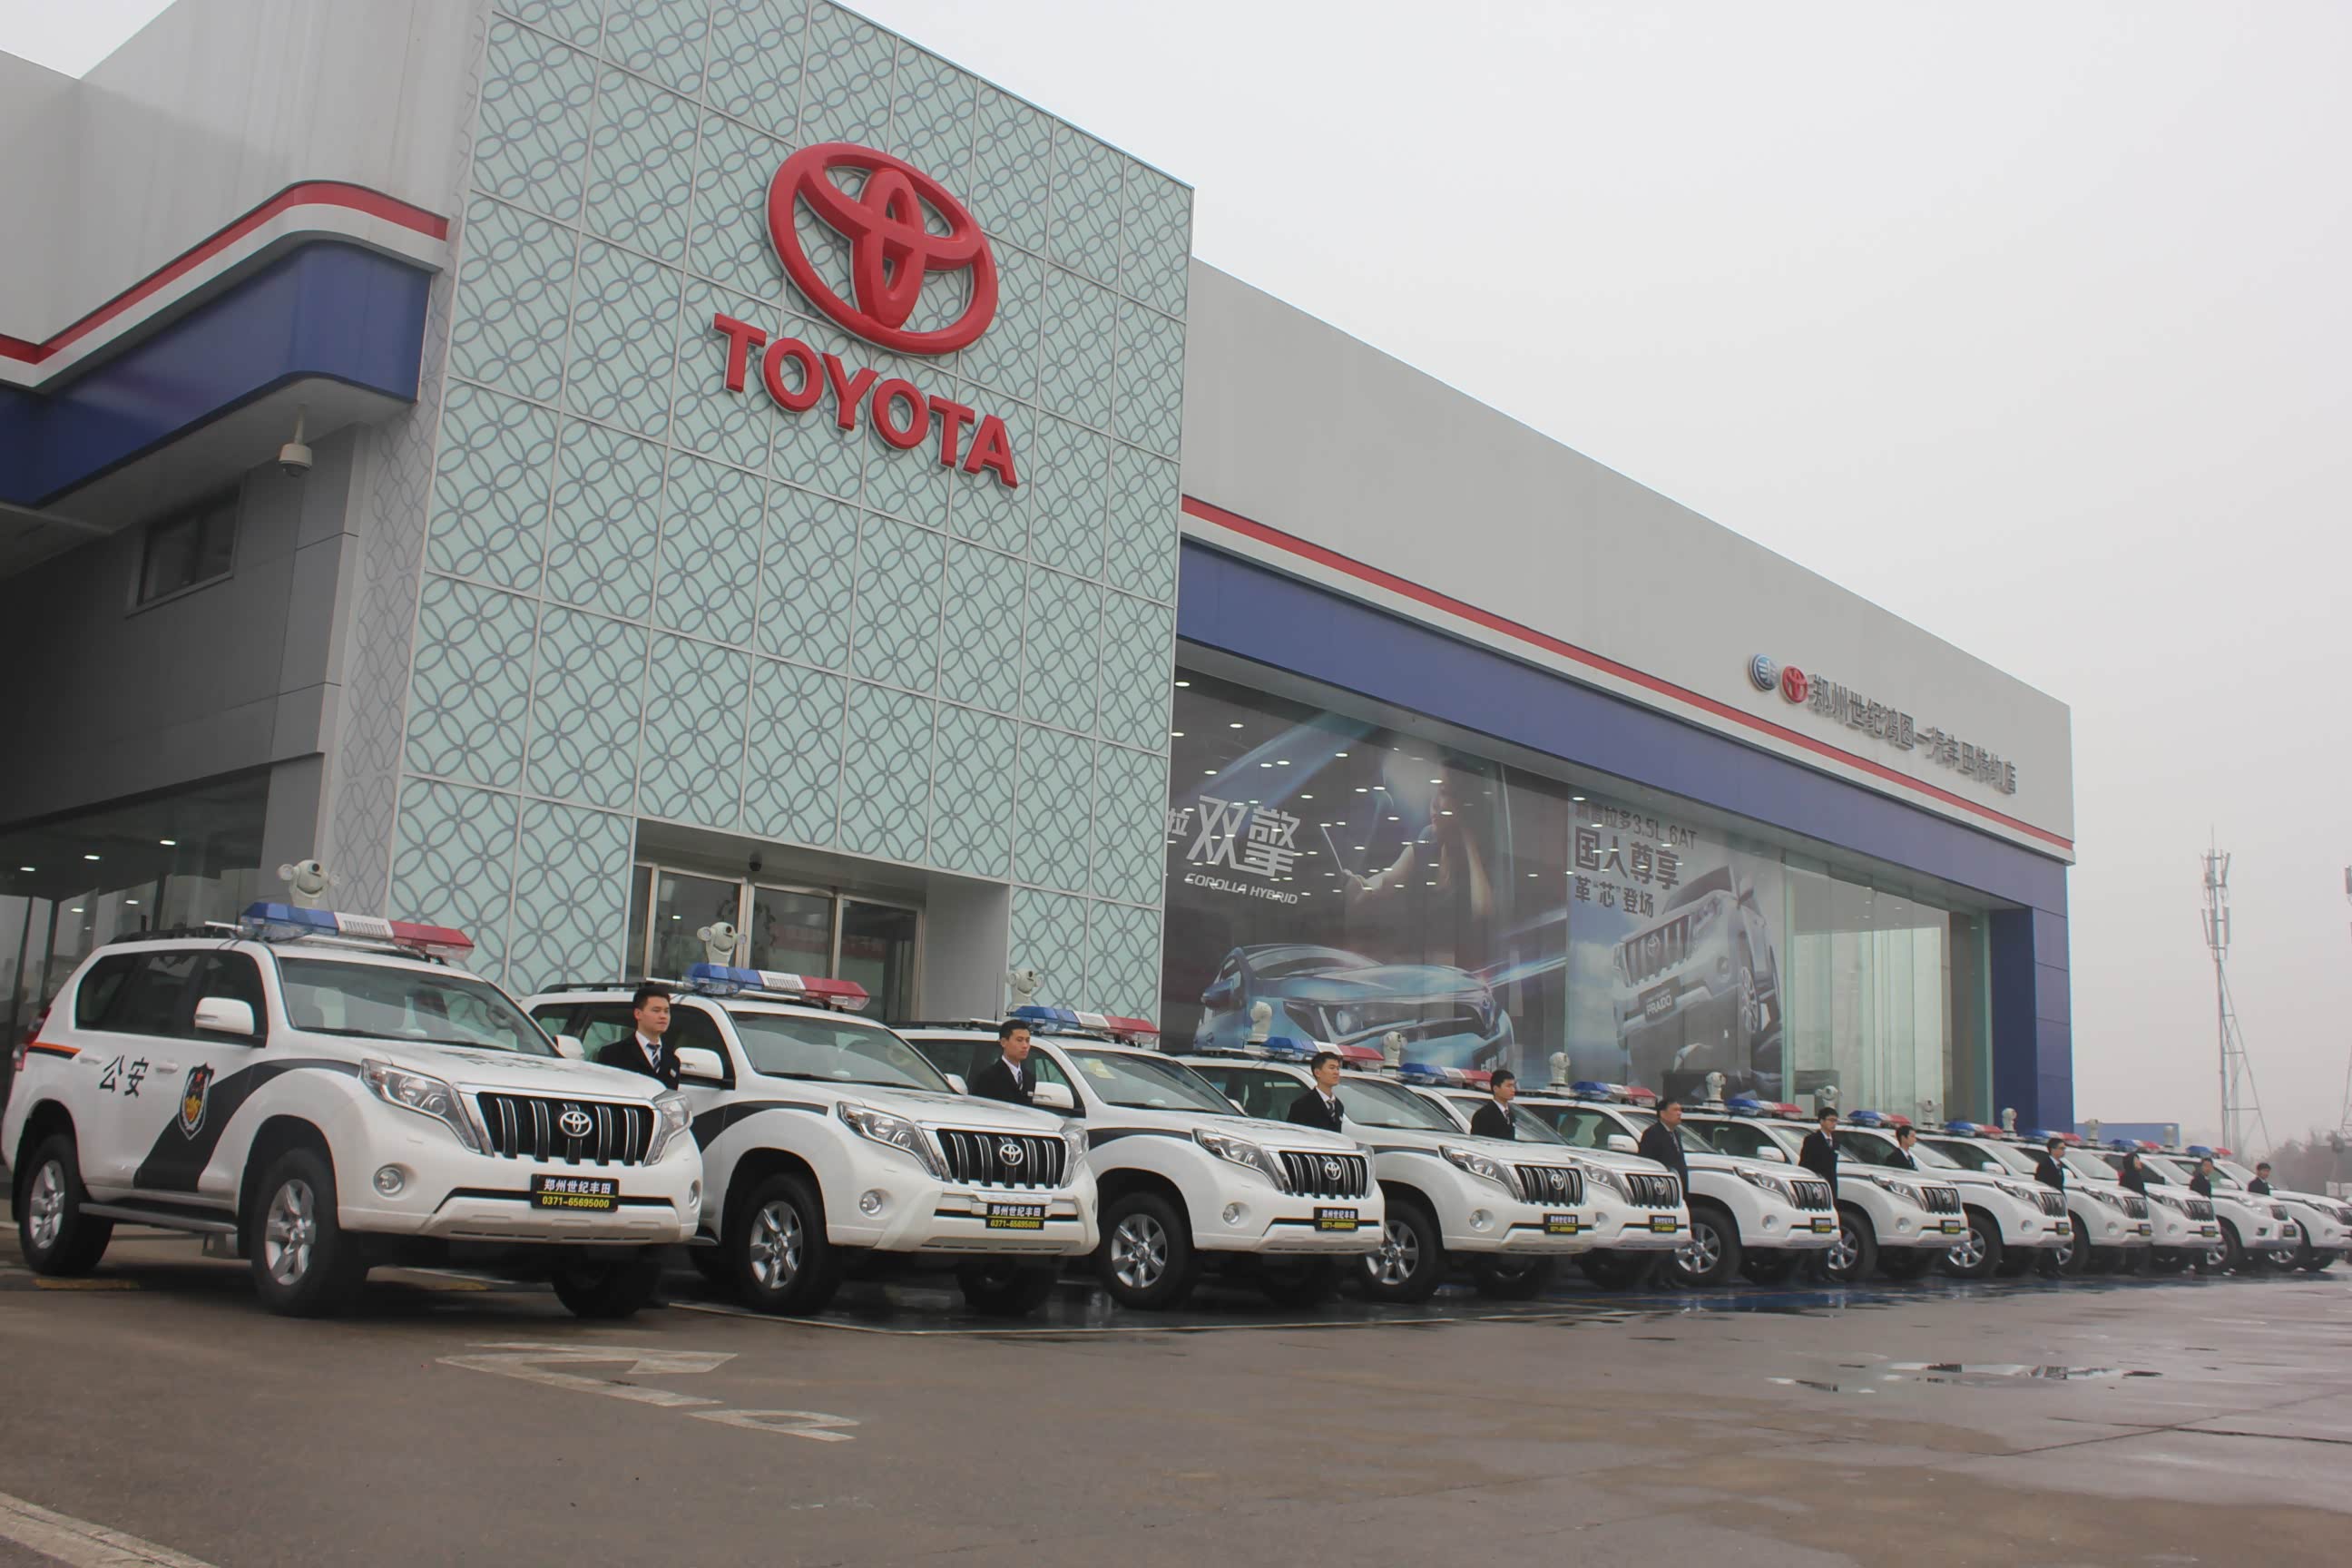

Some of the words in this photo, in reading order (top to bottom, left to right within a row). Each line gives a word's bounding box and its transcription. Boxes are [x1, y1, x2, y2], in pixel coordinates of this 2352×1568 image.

[713, 312, 1018, 489] TOYOTA
[1186, 794, 1301, 877] 双擎
[1669, 825, 1698, 849] 6AT
[1575, 826, 1680, 890] 国人尊享
[1184, 872, 1248, 895] COROLLA
[1250, 886, 1298, 905] HYBRID
[1646, 995, 1672, 1015] PRADO
[99, 1054, 150, 1098] 公安
[542, 1195, 610, 1209] 0371-65695000
[544, 1178, 612, 1194] 郑州世纪丰田
